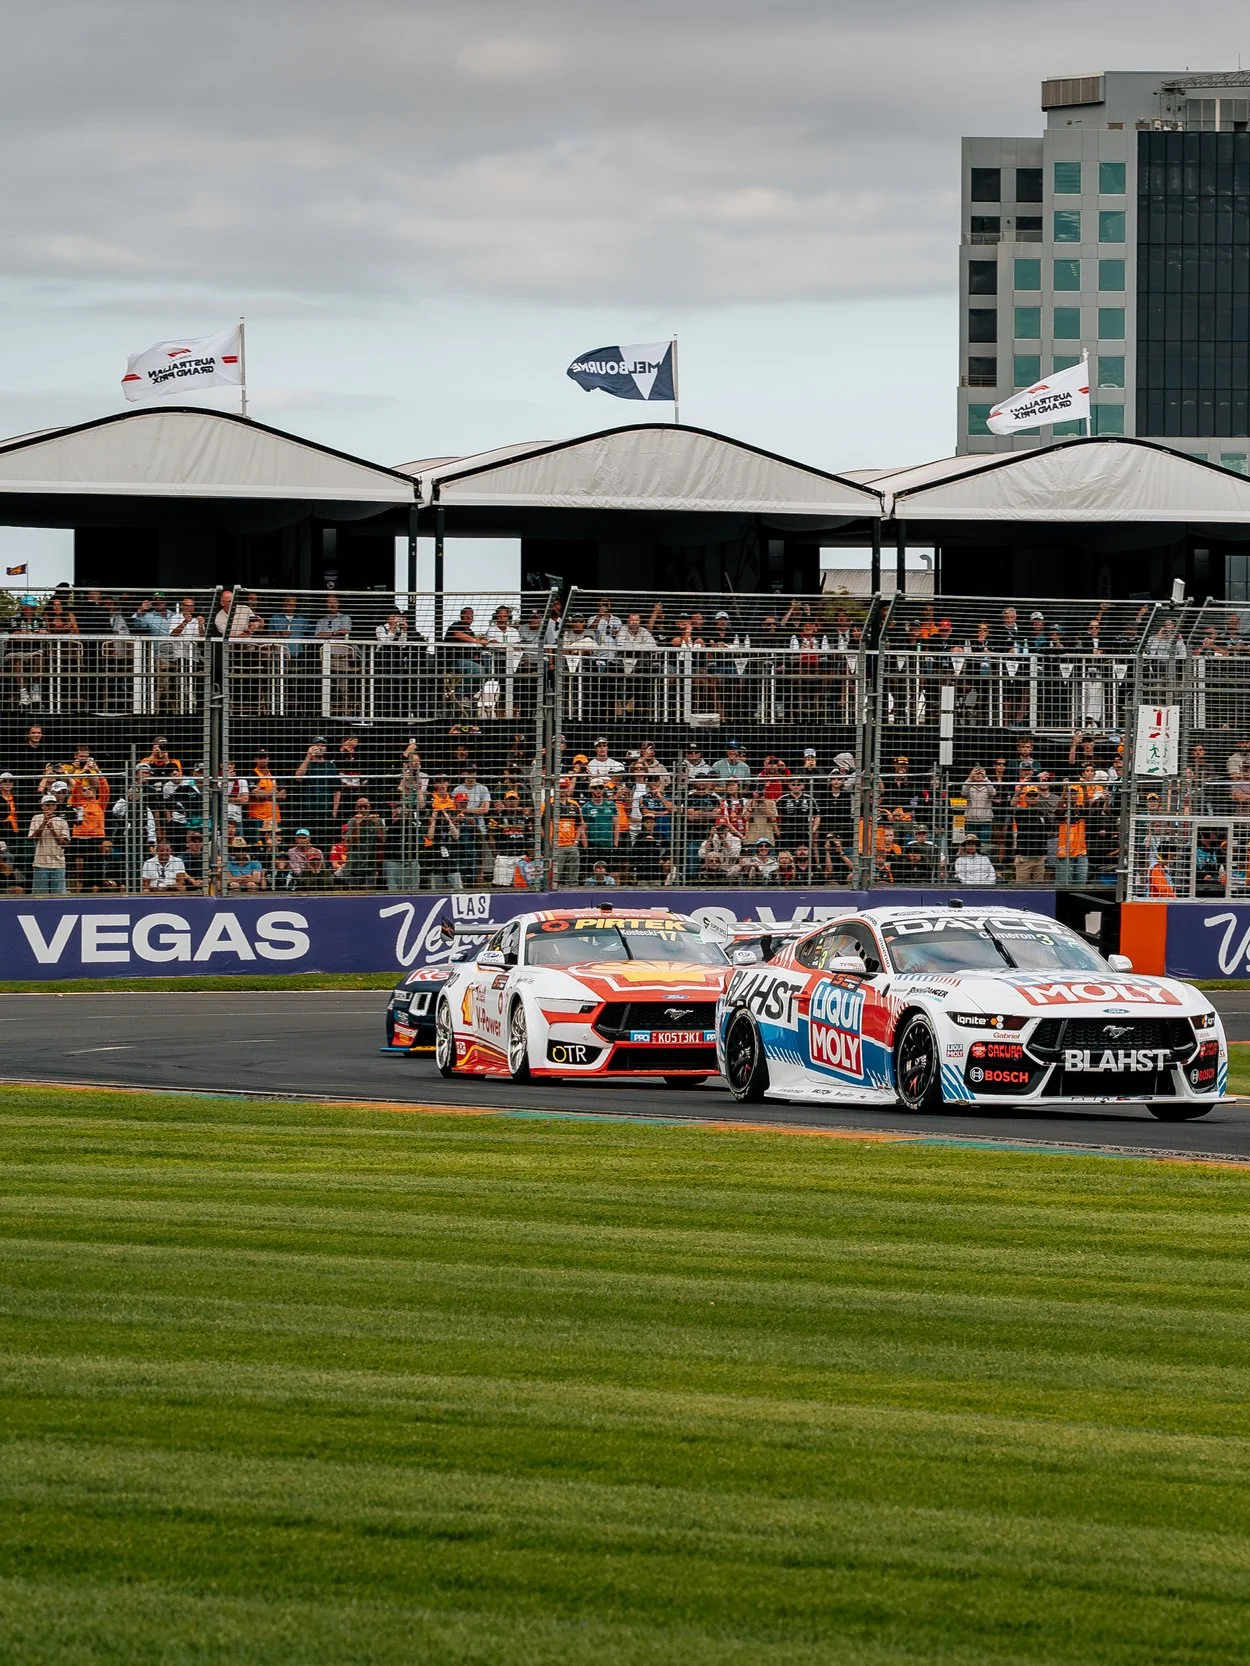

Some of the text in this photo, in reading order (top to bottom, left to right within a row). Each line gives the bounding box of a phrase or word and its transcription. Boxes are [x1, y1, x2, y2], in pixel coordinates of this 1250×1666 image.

[456, 895, 486, 916] LAS
[574, 918, 687, 931] PIRTEK
[17, 911, 310, 963] VEGAS
[657, 931, 678, 941] 17
[1036, 933, 1054, 945] 3
[818, 950, 828, 970] 3
[725, 970, 803, 1024] BLAHST
[1023, 984, 1169, 1003] MOLY
[813, 985, 861, 1030] LIQUI
[957, 1014, 986, 1025] ignite
[993, 1031, 1021, 1039] Gabriel
[552, 1045, 588, 1063] OTR
[812, 1023, 860, 1071] MOLY
[987, 1044, 1023, 1059] SAKURA
[1065, 1050, 1170, 1072] BLAHST
[985, 1070, 1029, 1083] BOSCH
